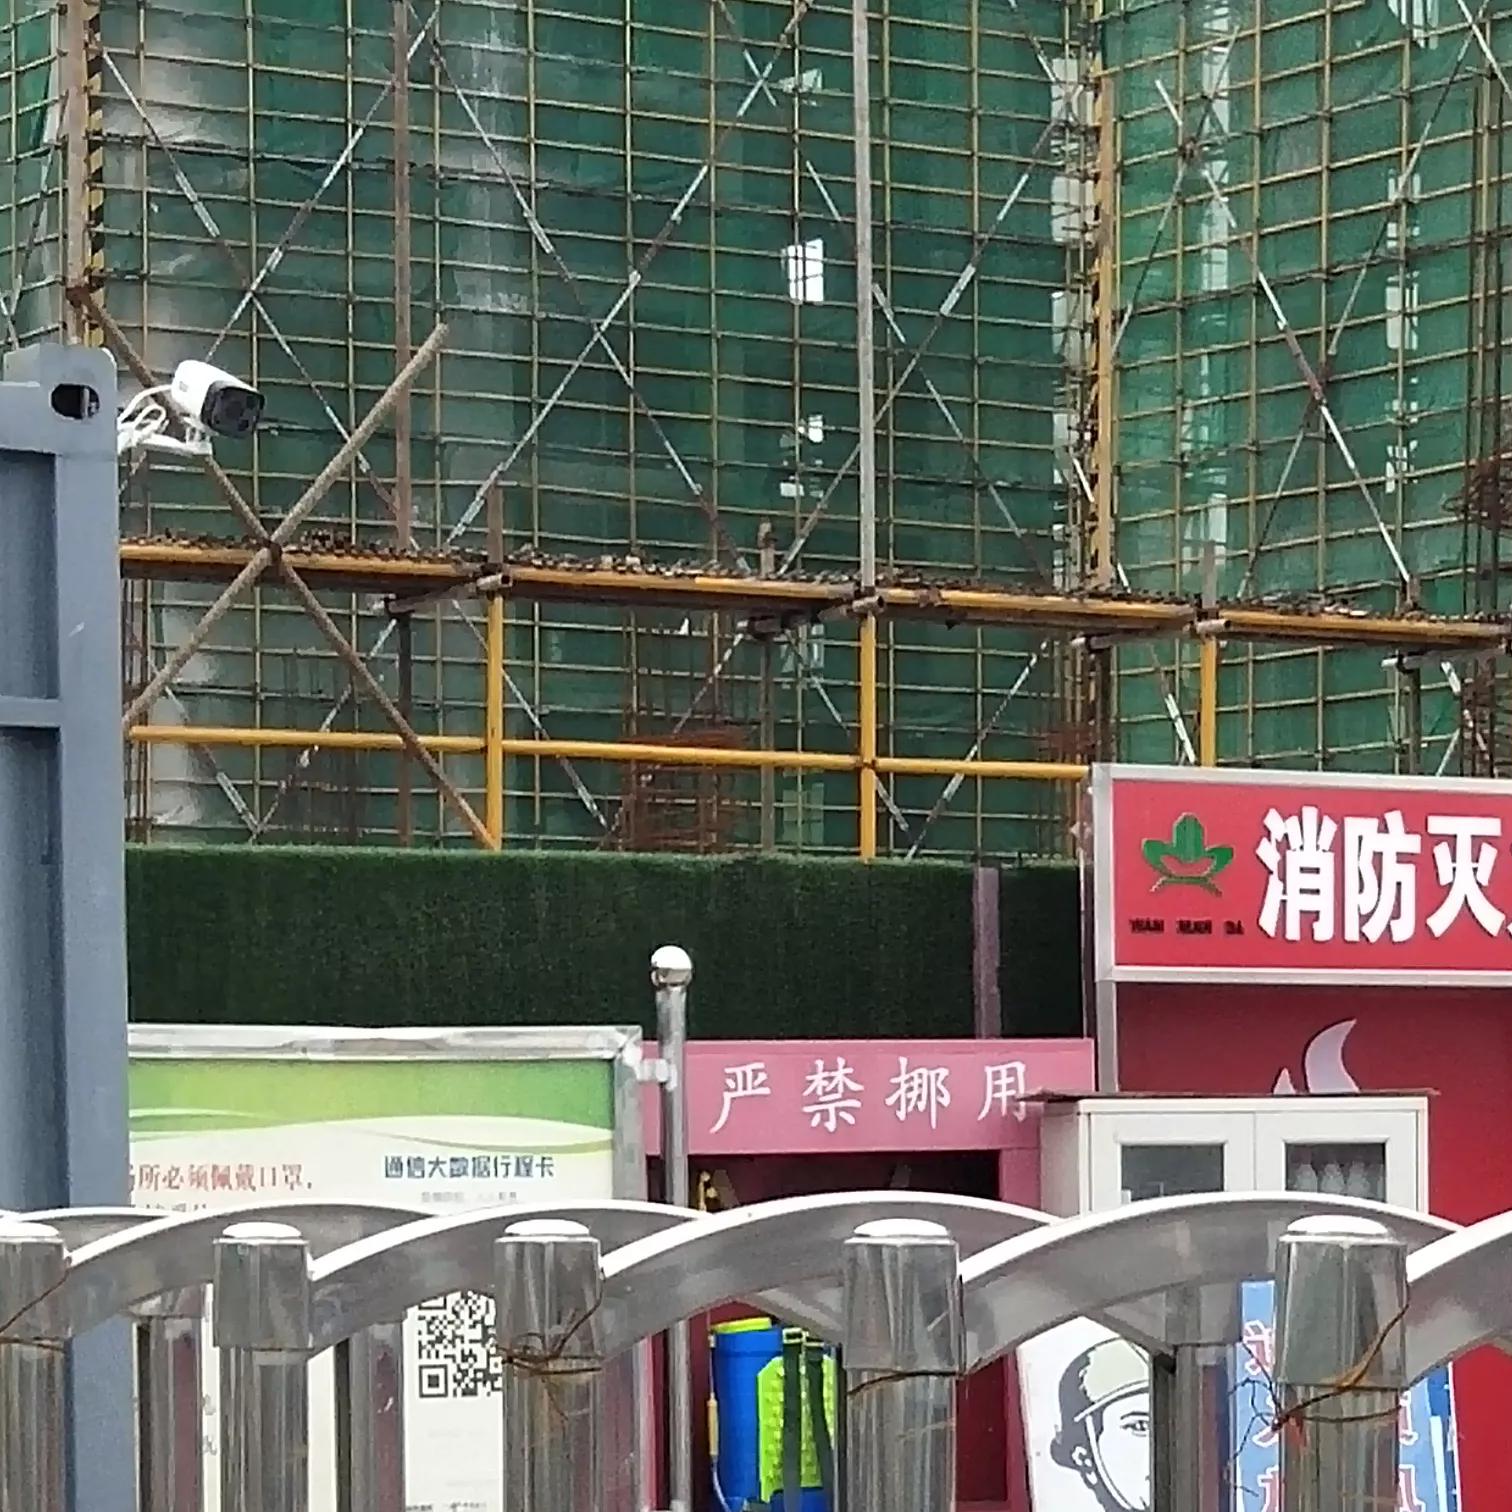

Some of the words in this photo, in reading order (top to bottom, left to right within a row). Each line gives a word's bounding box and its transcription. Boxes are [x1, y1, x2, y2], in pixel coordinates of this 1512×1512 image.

[709, 1056, 1028, 1135] 严禁挪用
[130, 1163, 313, 1193] 所必须佩戴口罩，
[384, 1155, 555, 1180] 通信大数据行程卡
